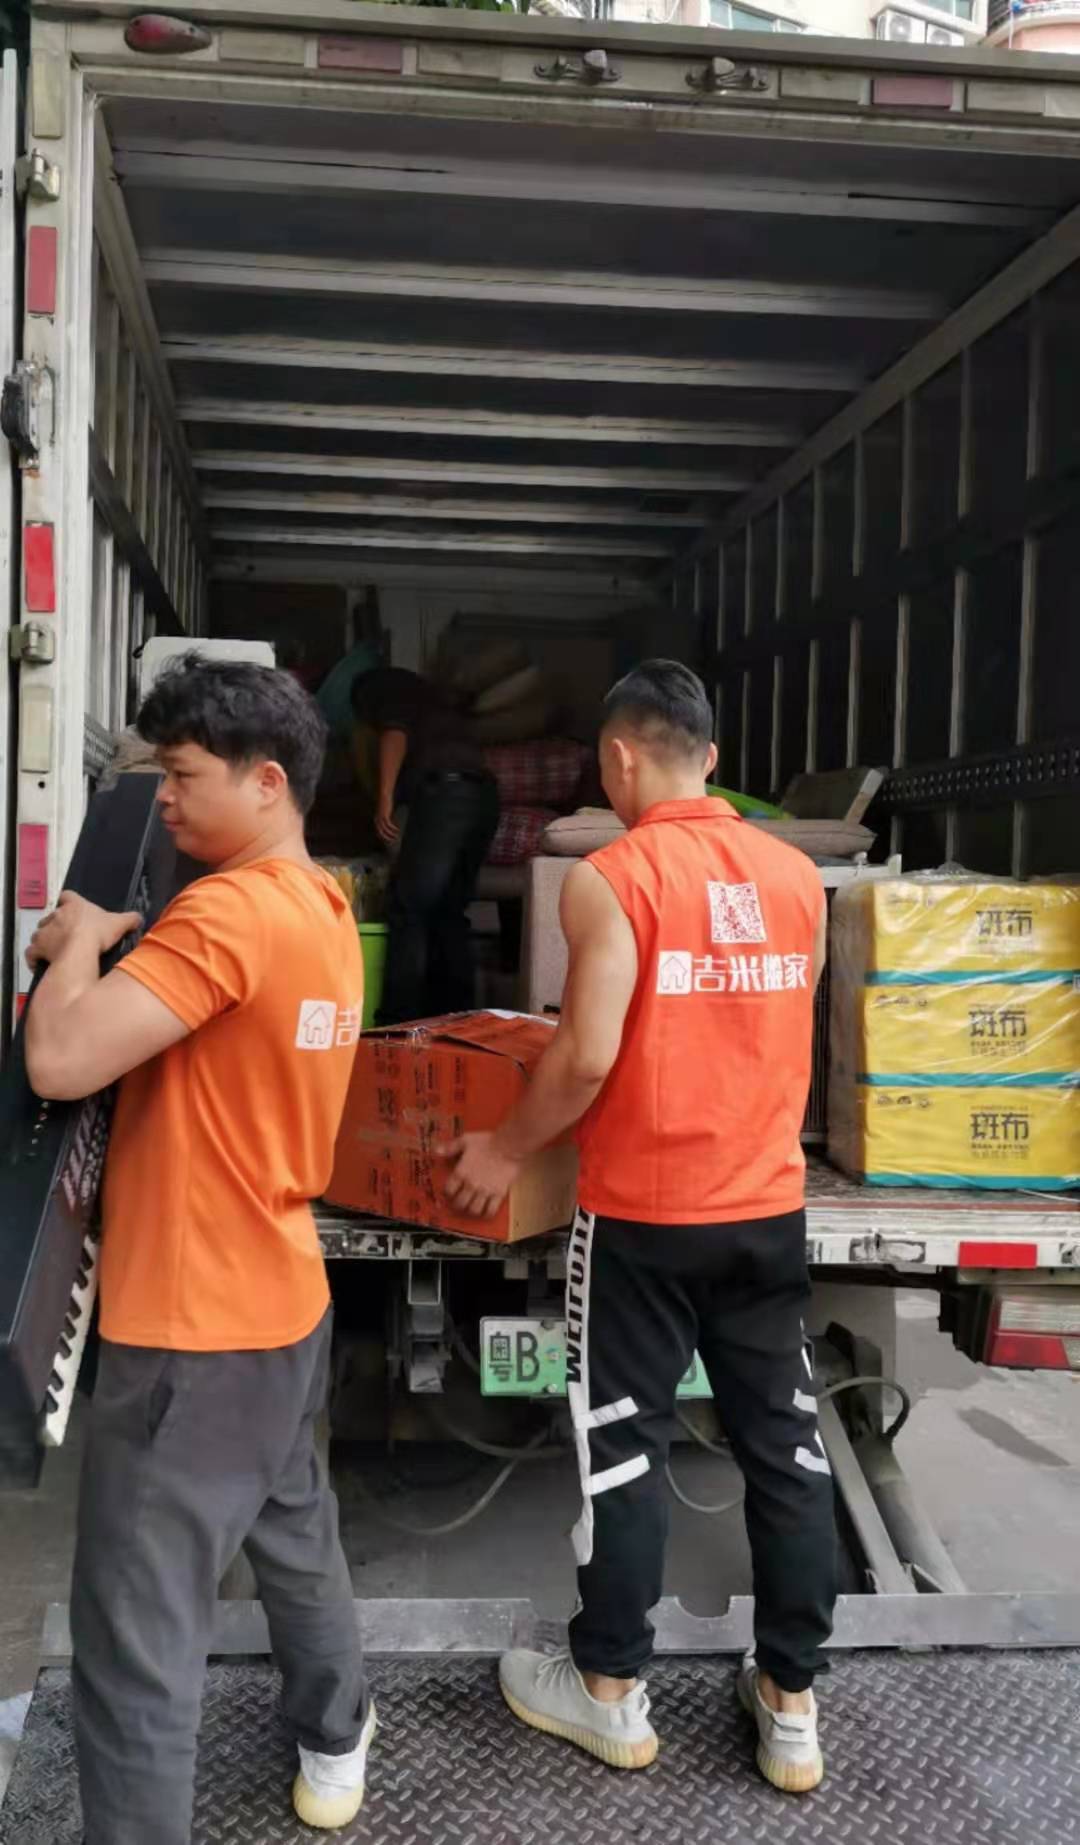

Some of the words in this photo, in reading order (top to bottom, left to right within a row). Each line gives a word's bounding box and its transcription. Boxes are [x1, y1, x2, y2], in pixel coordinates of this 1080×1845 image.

[693, 953, 809, 992] 吉米搬家
[970, 1112, 1029, 1141] 斑布
